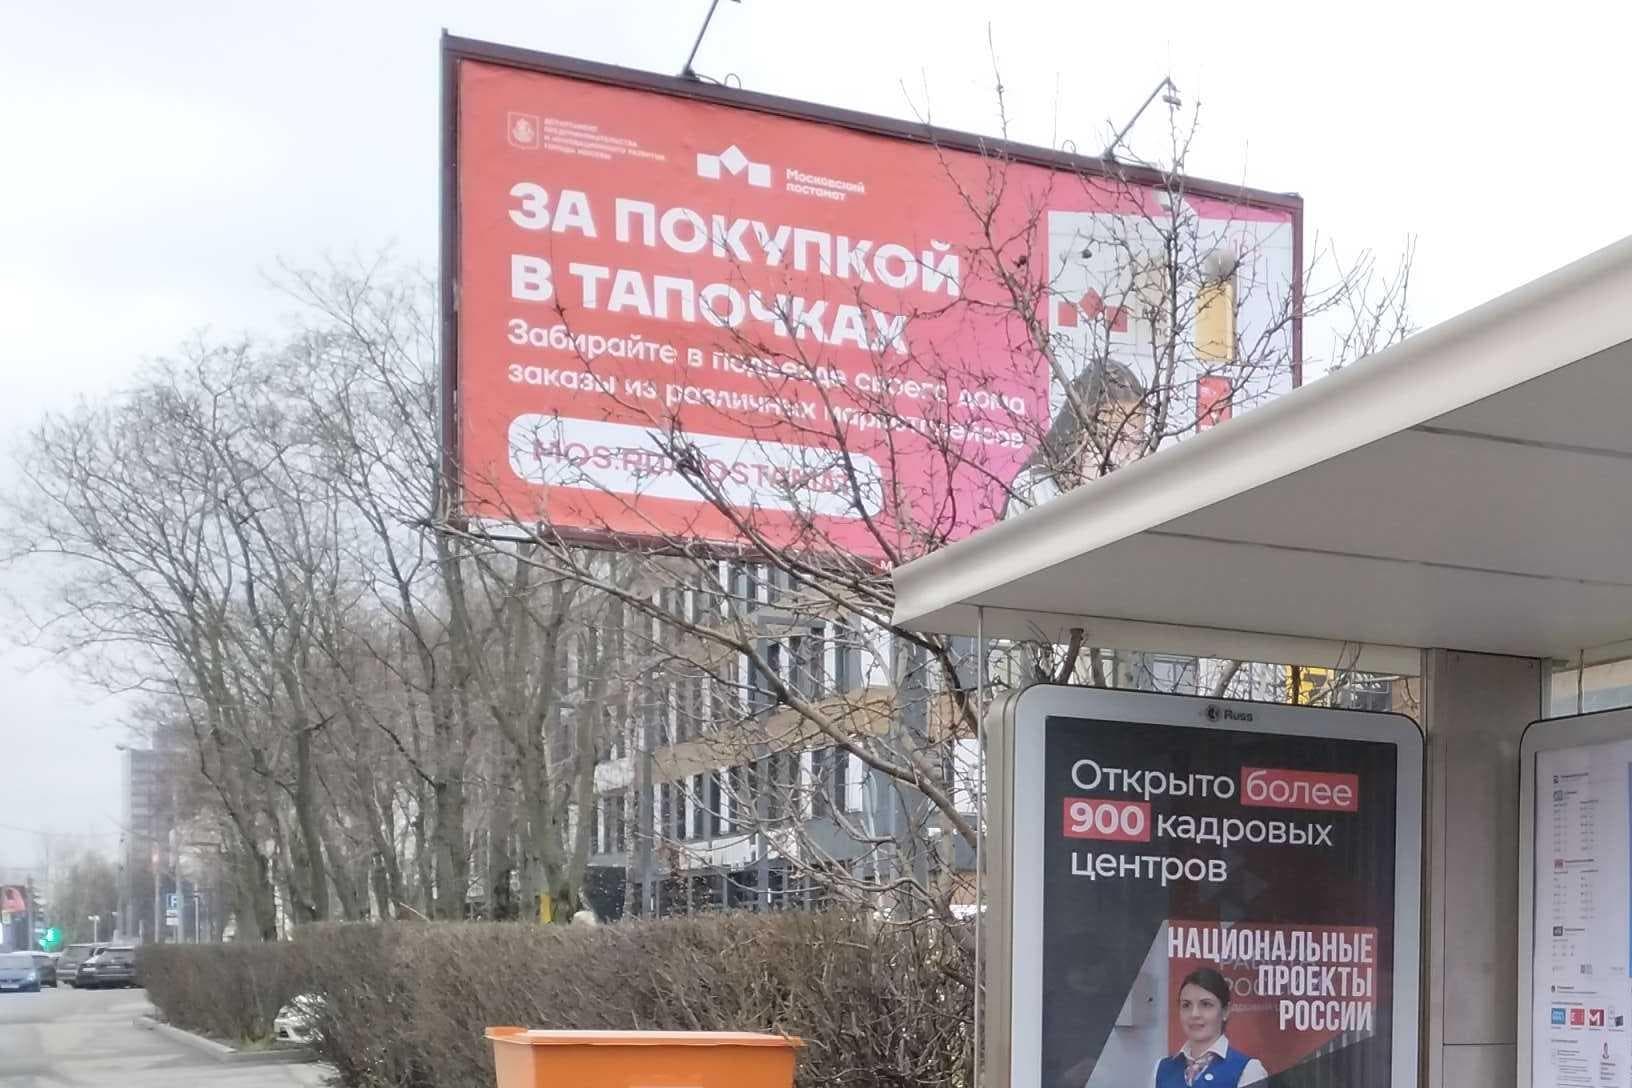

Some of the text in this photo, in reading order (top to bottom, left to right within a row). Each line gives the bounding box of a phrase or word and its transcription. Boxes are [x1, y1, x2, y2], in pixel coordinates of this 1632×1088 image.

[785, 182, 847, 201] постамат
[507, 181, 961, 297] ЗА ПОКУПКОЙ
[510, 253, 909, 355] В ТАПОЧКАХ
[507, 318, 678, 364] Забирайте
[687, 347, 704, 367] в
[507, 363, 615, 394] заказы
[624, 378, 657, 399] из
[1223, 708, 1254, 722] Russ
[1070, 758, 1353, 807] Открыто более
[1069, 801, 1334, 849] 900 кадровых
[1070, 851, 1228, 888] центров
[1167, 925, 1374, 964] НАЦИОНАЛЬНЫЕ
[1257, 964, 1373, 998] ПРОЕКТЫ
[1278, 999, 1373, 1032] РОССИИ
